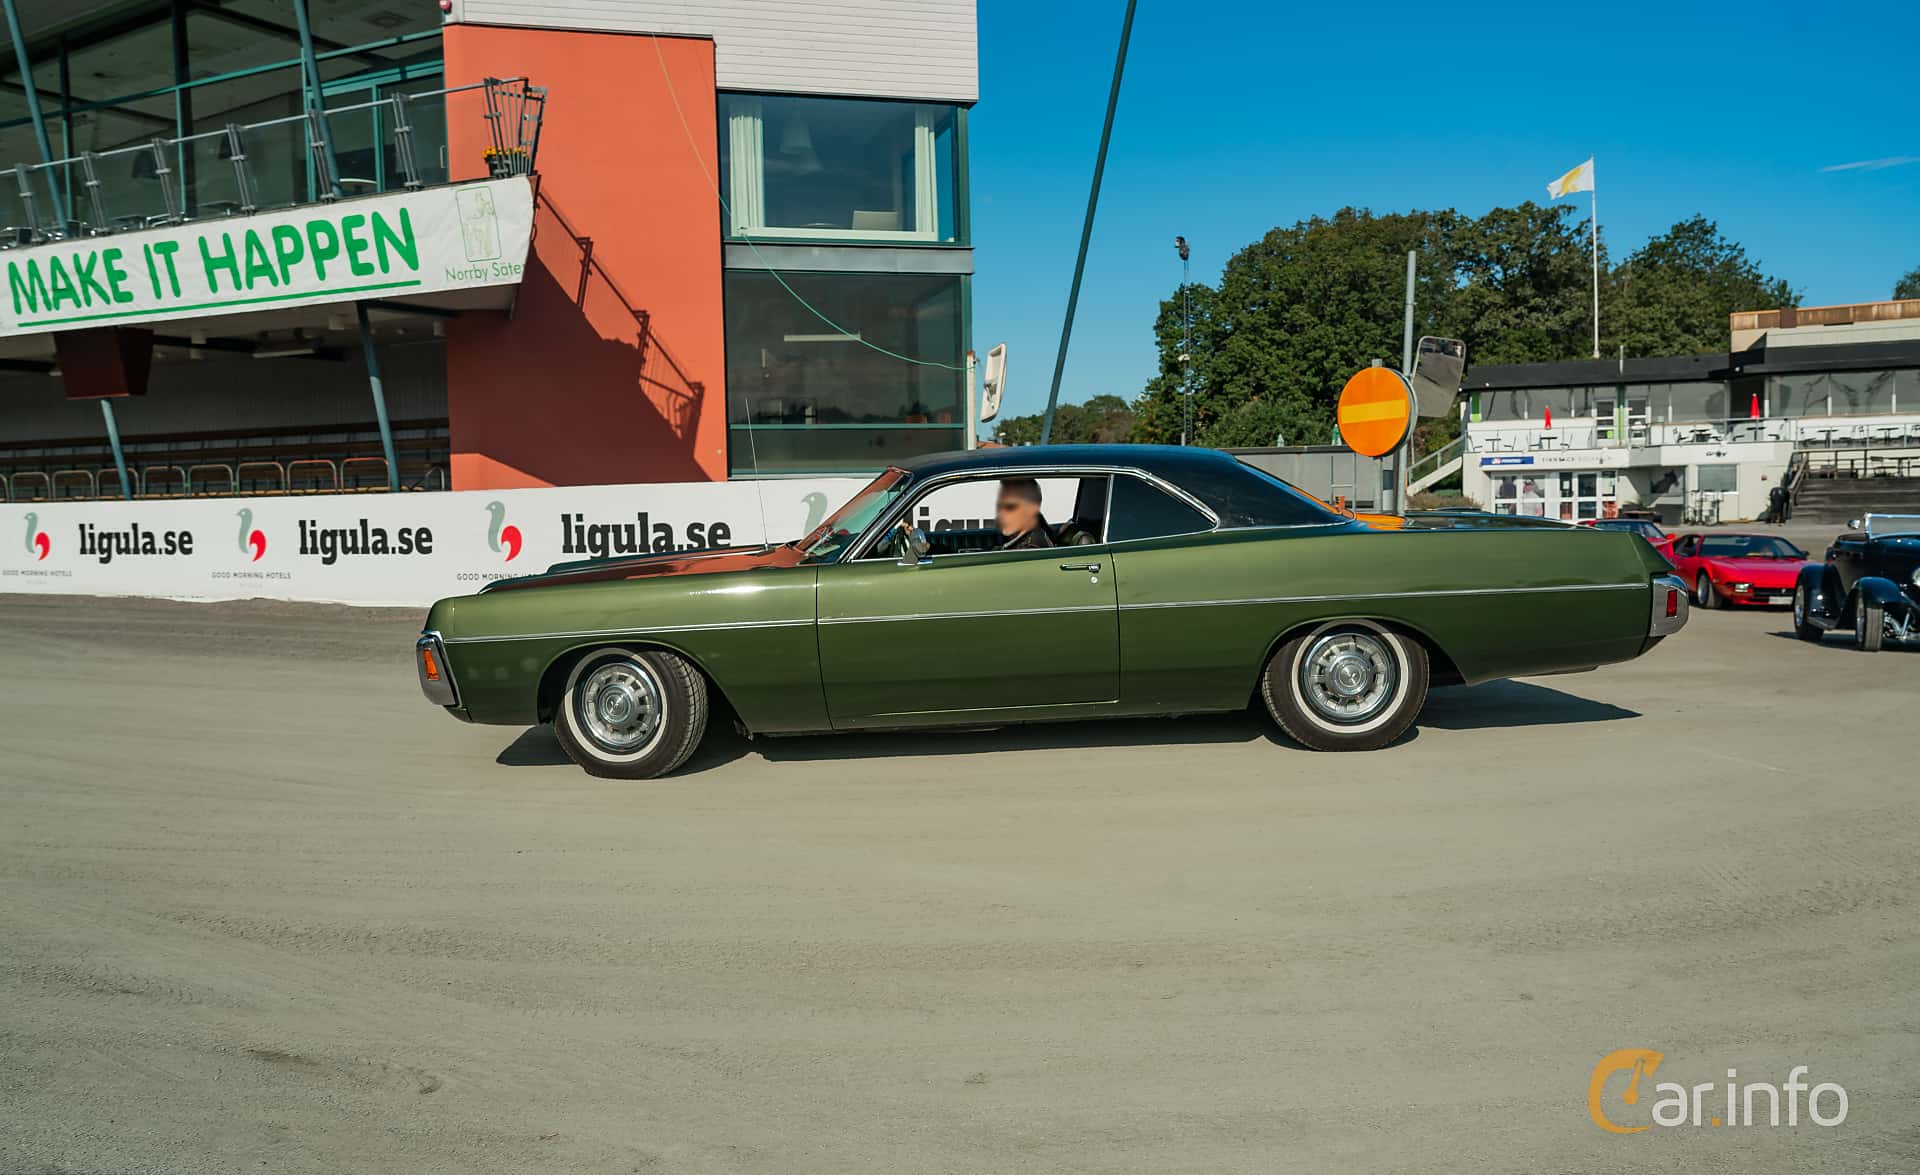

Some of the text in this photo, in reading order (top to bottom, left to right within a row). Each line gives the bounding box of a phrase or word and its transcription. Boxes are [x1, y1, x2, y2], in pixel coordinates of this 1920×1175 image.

[9, 208, 418, 314] MAKE IT HAPPEN
[446, 263, 489, 281] Norrby
[79, 523, 193, 564] ligula.se
[299, 519, 433, 565] ligula.se
[561, 512, 731, 559] ligula.se
[456, 573, 480, 581] GOOD
